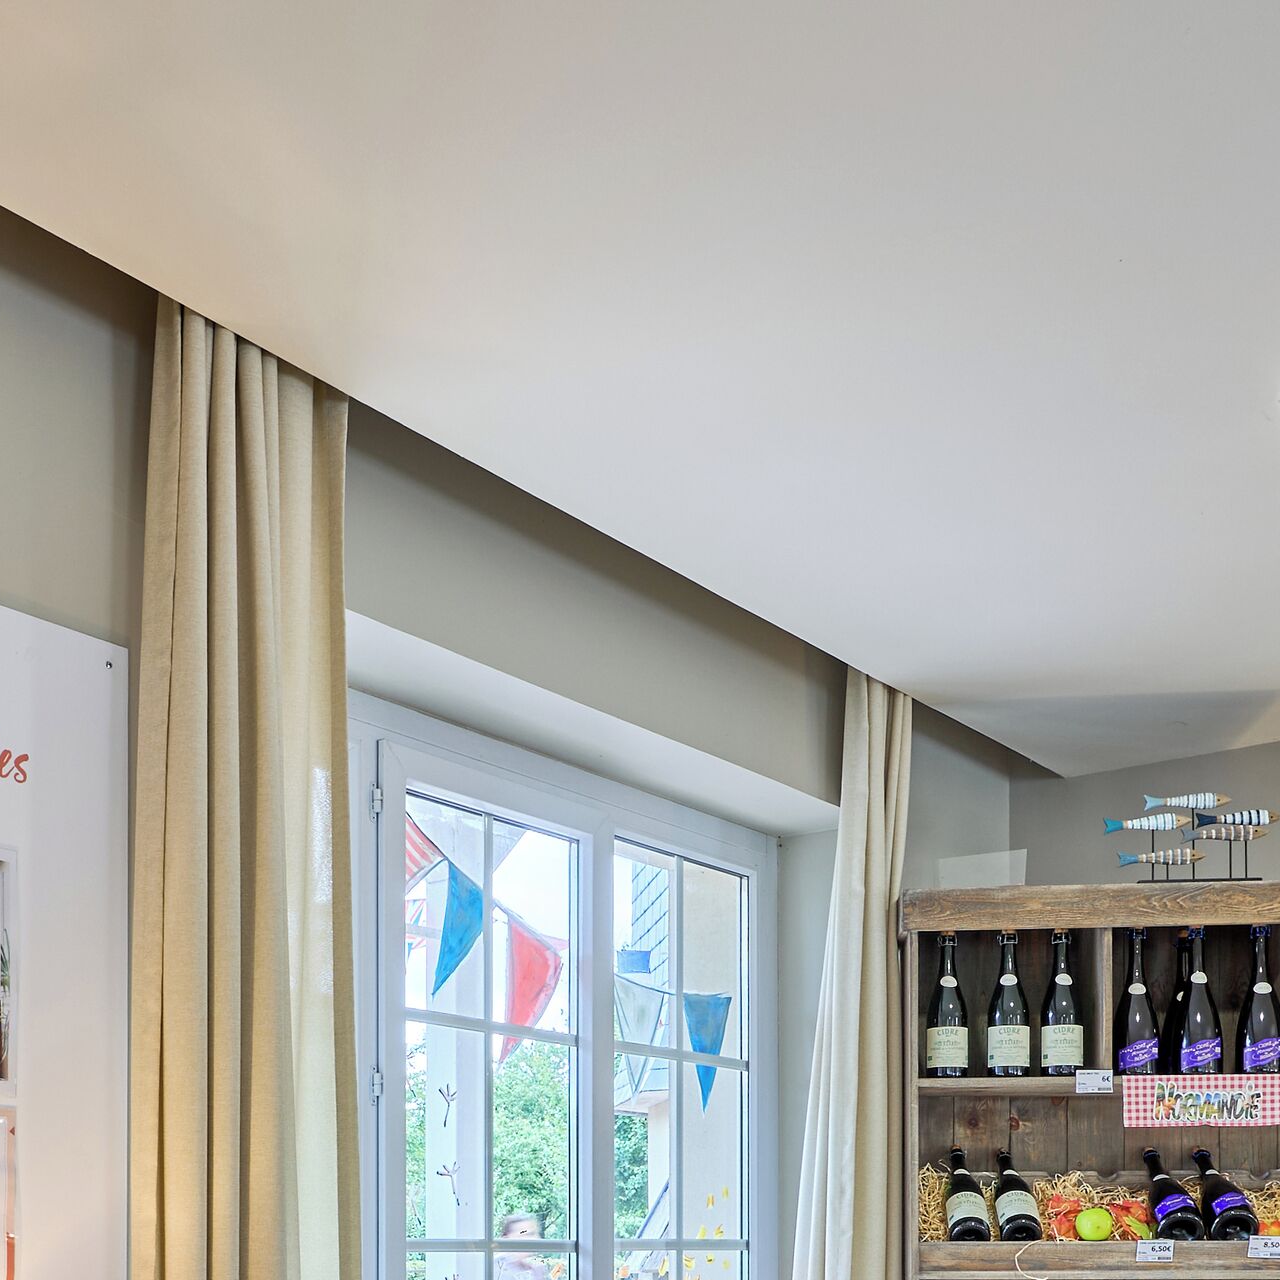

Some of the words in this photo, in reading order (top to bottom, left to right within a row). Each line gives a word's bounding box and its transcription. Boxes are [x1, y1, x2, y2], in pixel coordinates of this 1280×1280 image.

[937, 1028, 960, 1037] CIDRE
[998, 1027, 1021, 1036] CIDRE
[1052, 1026, 1076, 1035] CIDRE
[1102, 1075, 1111, 1083] 6€
